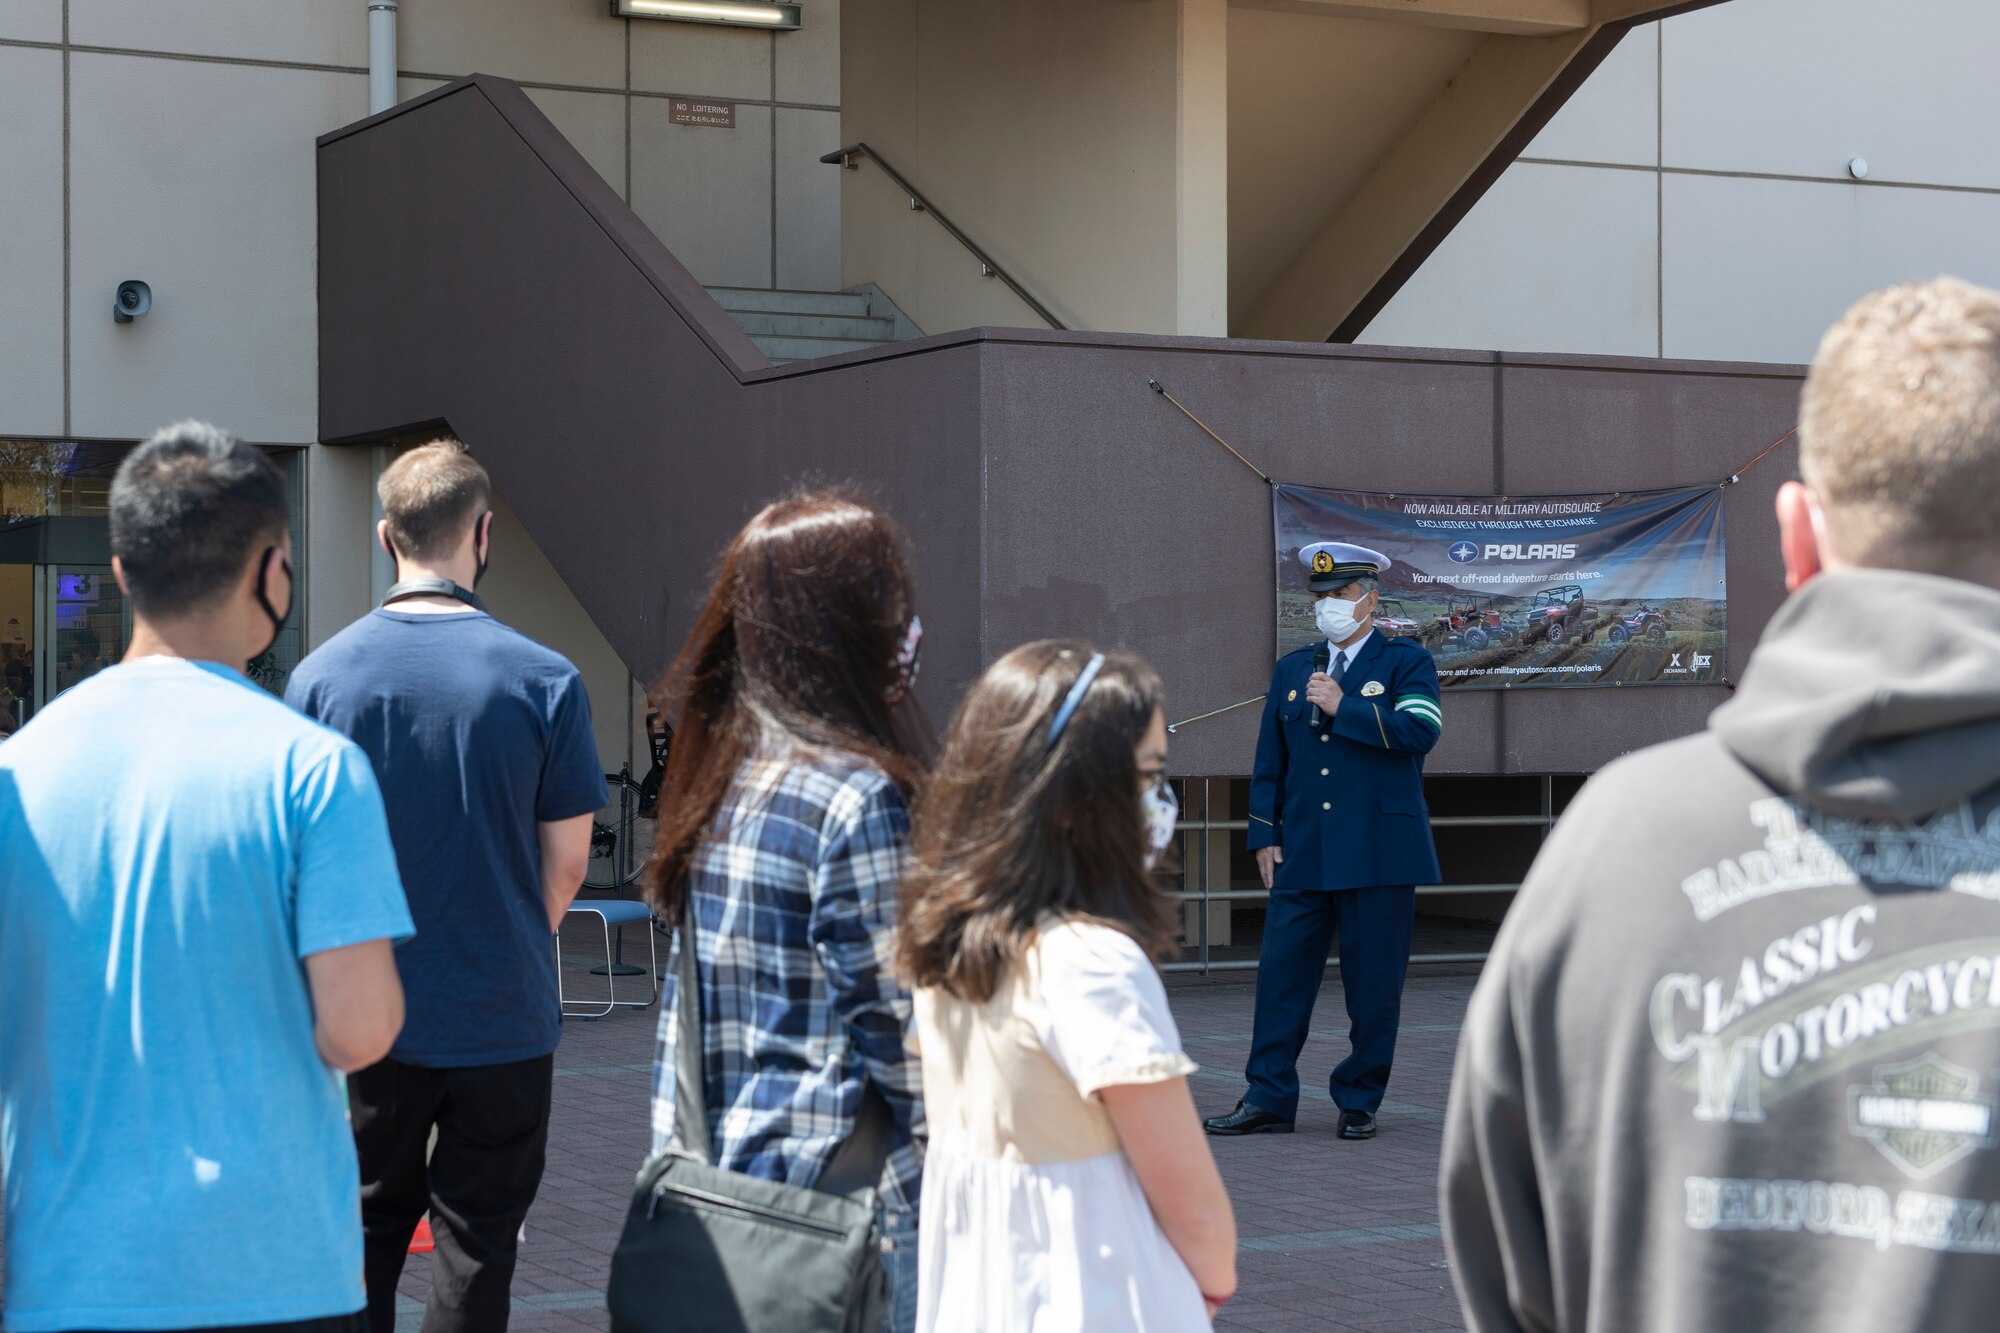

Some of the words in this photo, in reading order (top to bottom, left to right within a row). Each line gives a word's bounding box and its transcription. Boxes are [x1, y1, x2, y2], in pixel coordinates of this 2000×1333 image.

[676, 103, 687, 111] NO
[693, 105, 729, 114] LOITERING
[1404, 503, 1427, 515] NOW
[1428, 504, 1479, 516] AVAILABLE
[1481, 504, 1493, 515] AT
[1495, 503, 1540, 515] MILITARY
[1542, 502, 1601, 514] AUTOSOURCE
[1415, 519, 1477, 530] EXCLUSIVELY
[1477, 520, 1524, 530] THROUGH
[1524, 519, 1545, 529] THE
[1544, 516, 1598, 528] EXCHANGE
[1484, 544, 1576, 560] POLARIS
[1412, 573, 1435, 583] Your
[1436, 574, 1460, 584] next
[1461, 573, 1500, 584] off-road
[1502, 573, 1548, 584] adventure
[1548, 572, 1575, 582] starts
[1576, 570, 1604, 581] here.
[1494, 664, 1602, 676] militaryautosource.com/polaris
[1650, 905, 1877, 1062] CLASSIC
